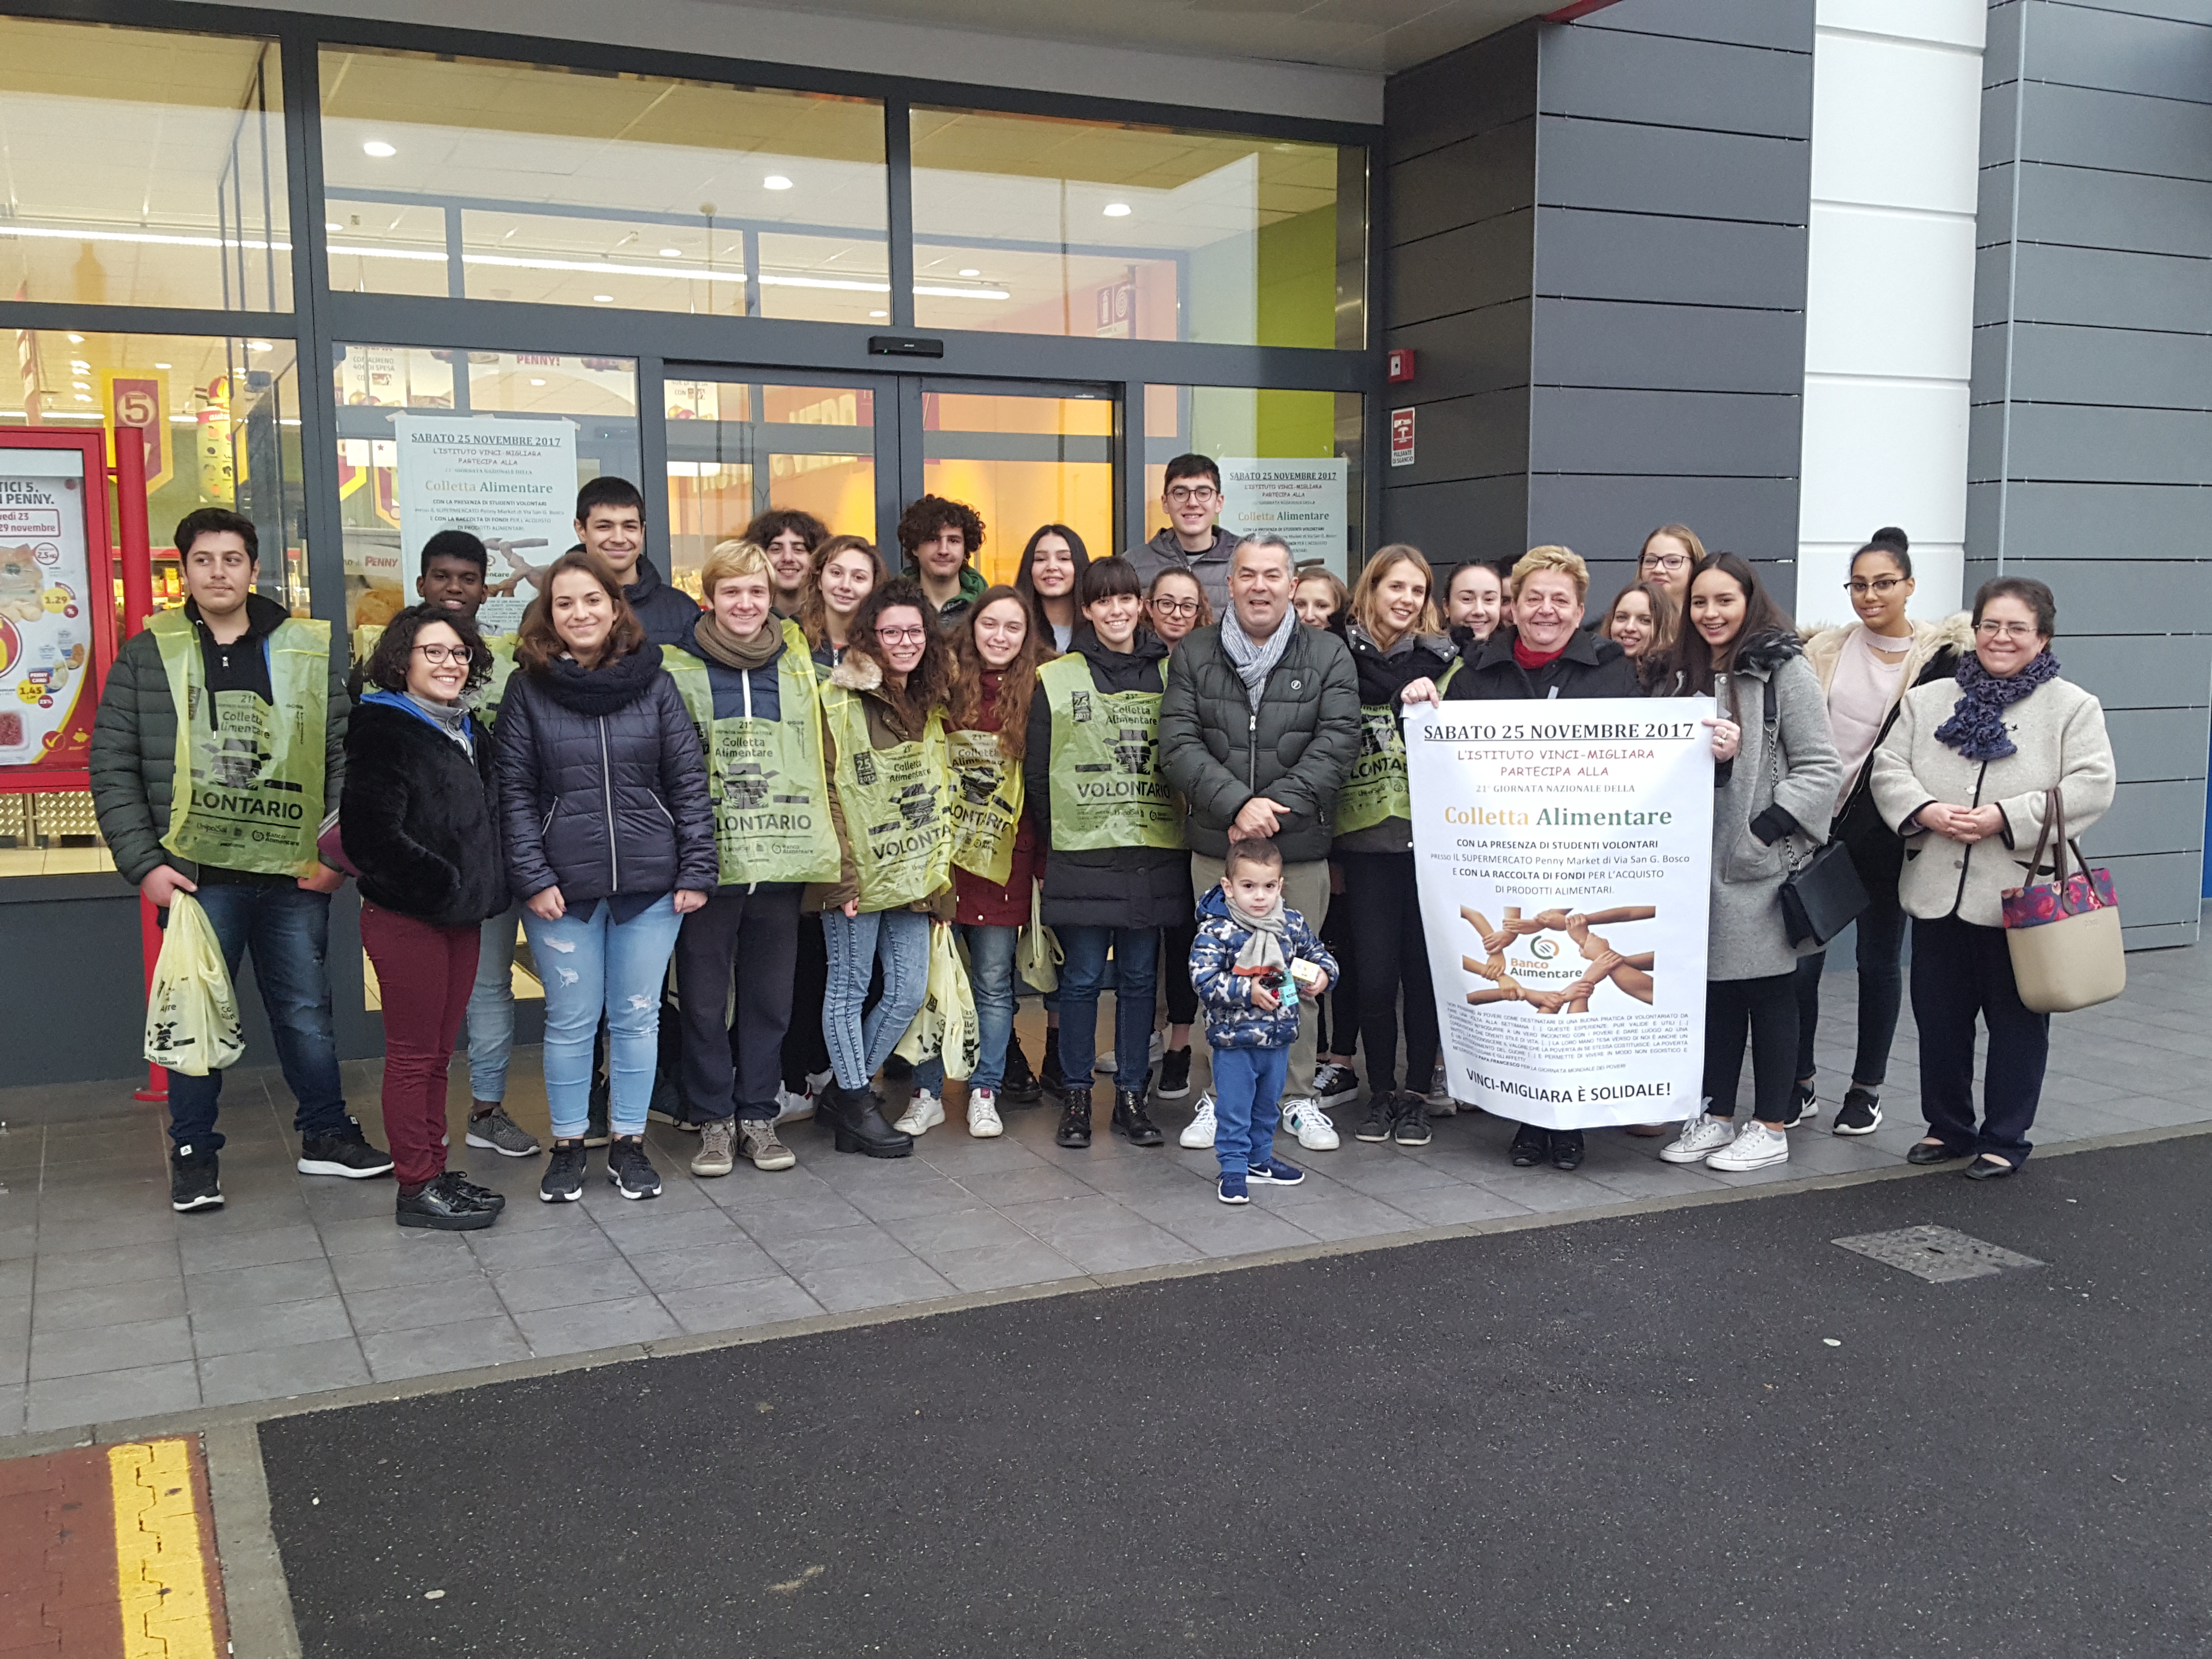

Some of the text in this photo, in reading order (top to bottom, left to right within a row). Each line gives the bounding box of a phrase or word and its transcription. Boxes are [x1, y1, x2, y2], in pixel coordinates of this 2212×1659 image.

[516, 354, 560, 366] PENNY!
[125, 395, 149, 424] 5
[411, 433, 561, 446] SABATO 25 NOVEMBRE 2017
[26, 482, 38, 492] 5.
[425, 480, 553, 494] Colletta Alimentare
[6, 494, 54, 504] PENNY.
[1239, 511, 1329, 521] Colletta Alimentare
[365, 556, 398, 567] PENNY
[1074, 696, 1088, 707] 25
[1112, 706, 1150, 715] Colletta
[223, 711, 263, 726] Colletta
[1106, 715, 1157, 725] Alimentare
[220, 723, 270, 740] limentare
[1424, 723, 1693, 740] SABATO 25 NOVEMBRE 2017
[723, 737, 765, 747] Colletta
[715, 748, 773, 757] Alimentare
[958, 748, 1000, 757] Colletta
[1458, 749, 1655, 760] L'ISTITUTO VINCI-MIGLIARA
[857, 758, 871, 771] 25
[894, 760, 922, 772] Colletta
[889, 768, 931, 783] Alimentare
[1501, 766, 1608, 776] PARTECIPA ALLA
[1077, 781, 1170, 798] VOLONTARIO
[191, 788, 303, 820] LONTARIO
[1445, 806, 1672, 826] Colletta Alimentare
[716, 815, 812, 832] LONTARIO
[1457, 839, 1475, 848] CON
[1477, 840, 1487, 848] LA
[1490, 840, 1536, 849] PRESENZA
[1552, 841, 1600, 849] STUDENTI
[1602, 841, 1657, 849] VOLONTARI
[1462, 854, 1532, 864] SUPERMERCATO
[1535, 856, 1564, 867] Penny
[1567, 856, 1600, 864] Market
[1603, 856, 1611, 864] di
[1614, 856, 1627, 864] Via
[1650, 855, 1660, 863] G.
[1663, 855, 1690, 863] Bosco
[1460, 868, 1477, 878] CON
[1480, 869, 1490, 878] LA
[1492, 870, 1540, 880] RACCOLTA
[1542, 871, 1552, 879] DI
[1555, 871, 1585, 879] FONDI
[1588, 871, 1605, 879] PER
[1608, 870, 1663, 879] L'ACQUISTO
[1495, 885, 1504, 893] DI
[1507, 886, 1552, 895] PRODOTTI
[1511, 958, 1549, 969] Banco
[1510, 967, 1582, 978] Alimentare
[1490, 1058, 1520, 1068] FRANCESCO
[1466, 1068, 1671, 1103] VINCI-MIGLIARA È SOLIDALE!
